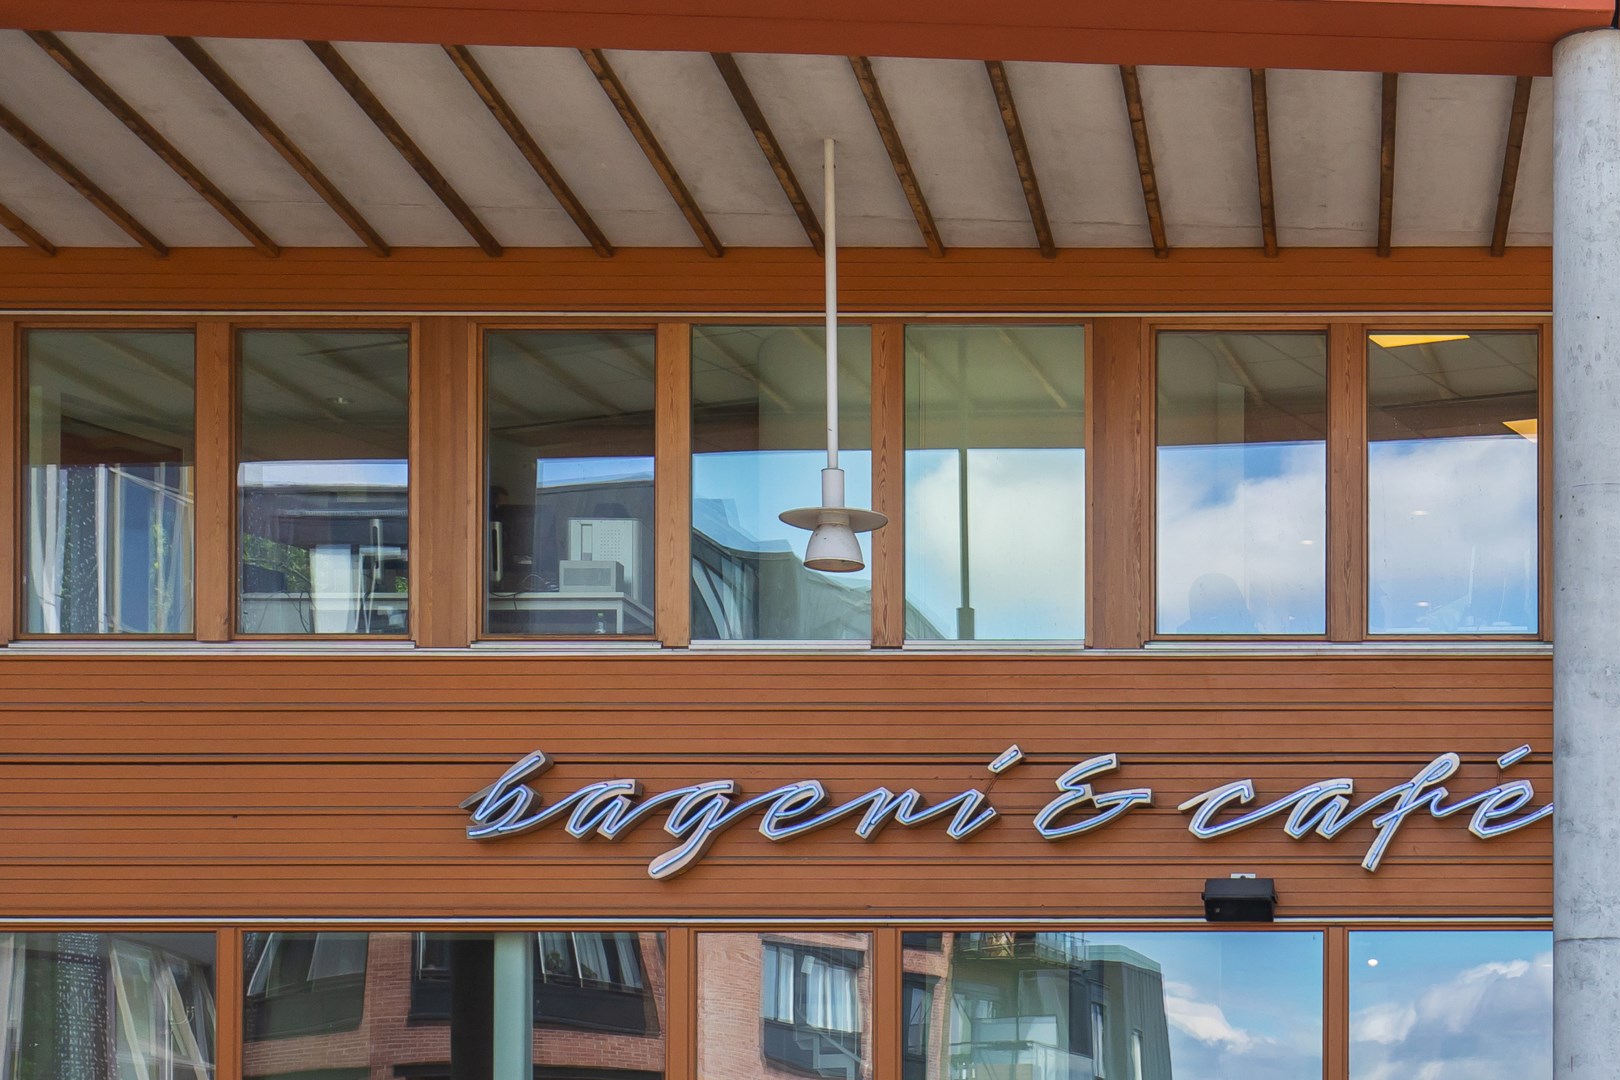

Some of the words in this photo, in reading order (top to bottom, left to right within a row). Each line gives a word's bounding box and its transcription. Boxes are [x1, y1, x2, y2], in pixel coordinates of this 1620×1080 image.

[459, 743, 1024, 881] bageri
[1033, 752, 1155, 841] &
[1177, 744, 1554, 872] café
